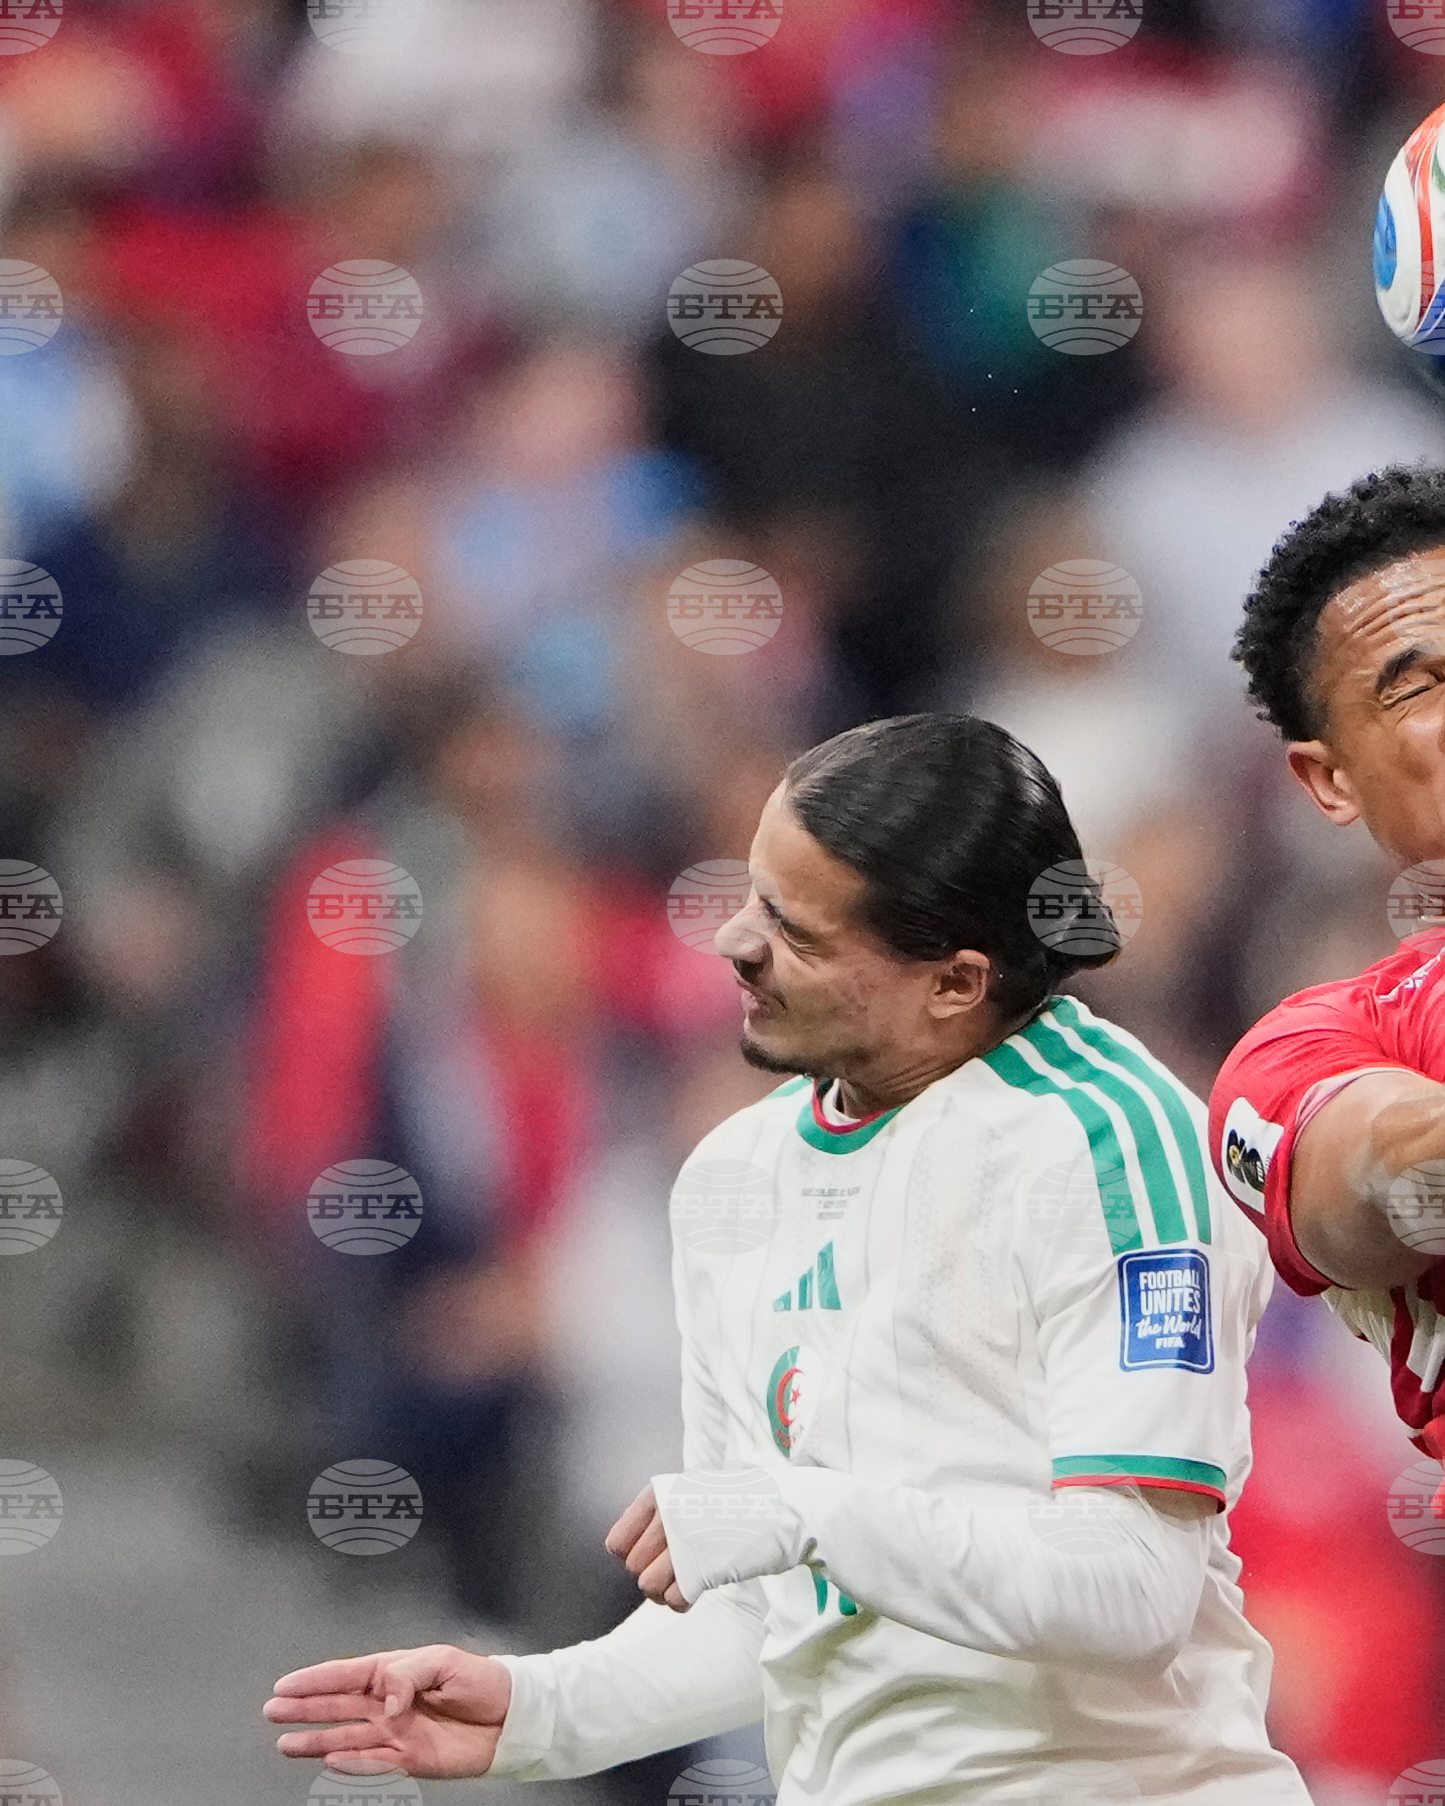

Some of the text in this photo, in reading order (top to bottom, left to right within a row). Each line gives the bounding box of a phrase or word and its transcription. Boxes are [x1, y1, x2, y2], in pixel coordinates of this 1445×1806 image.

[1139, 1268, 1202, 1290] FOOTBALL
[1140, 1287, 1202, 1316] UNITES
[1135, 1314, 1202, 1340] the World
[1155, 1336, 1186, 1349] FIFA
